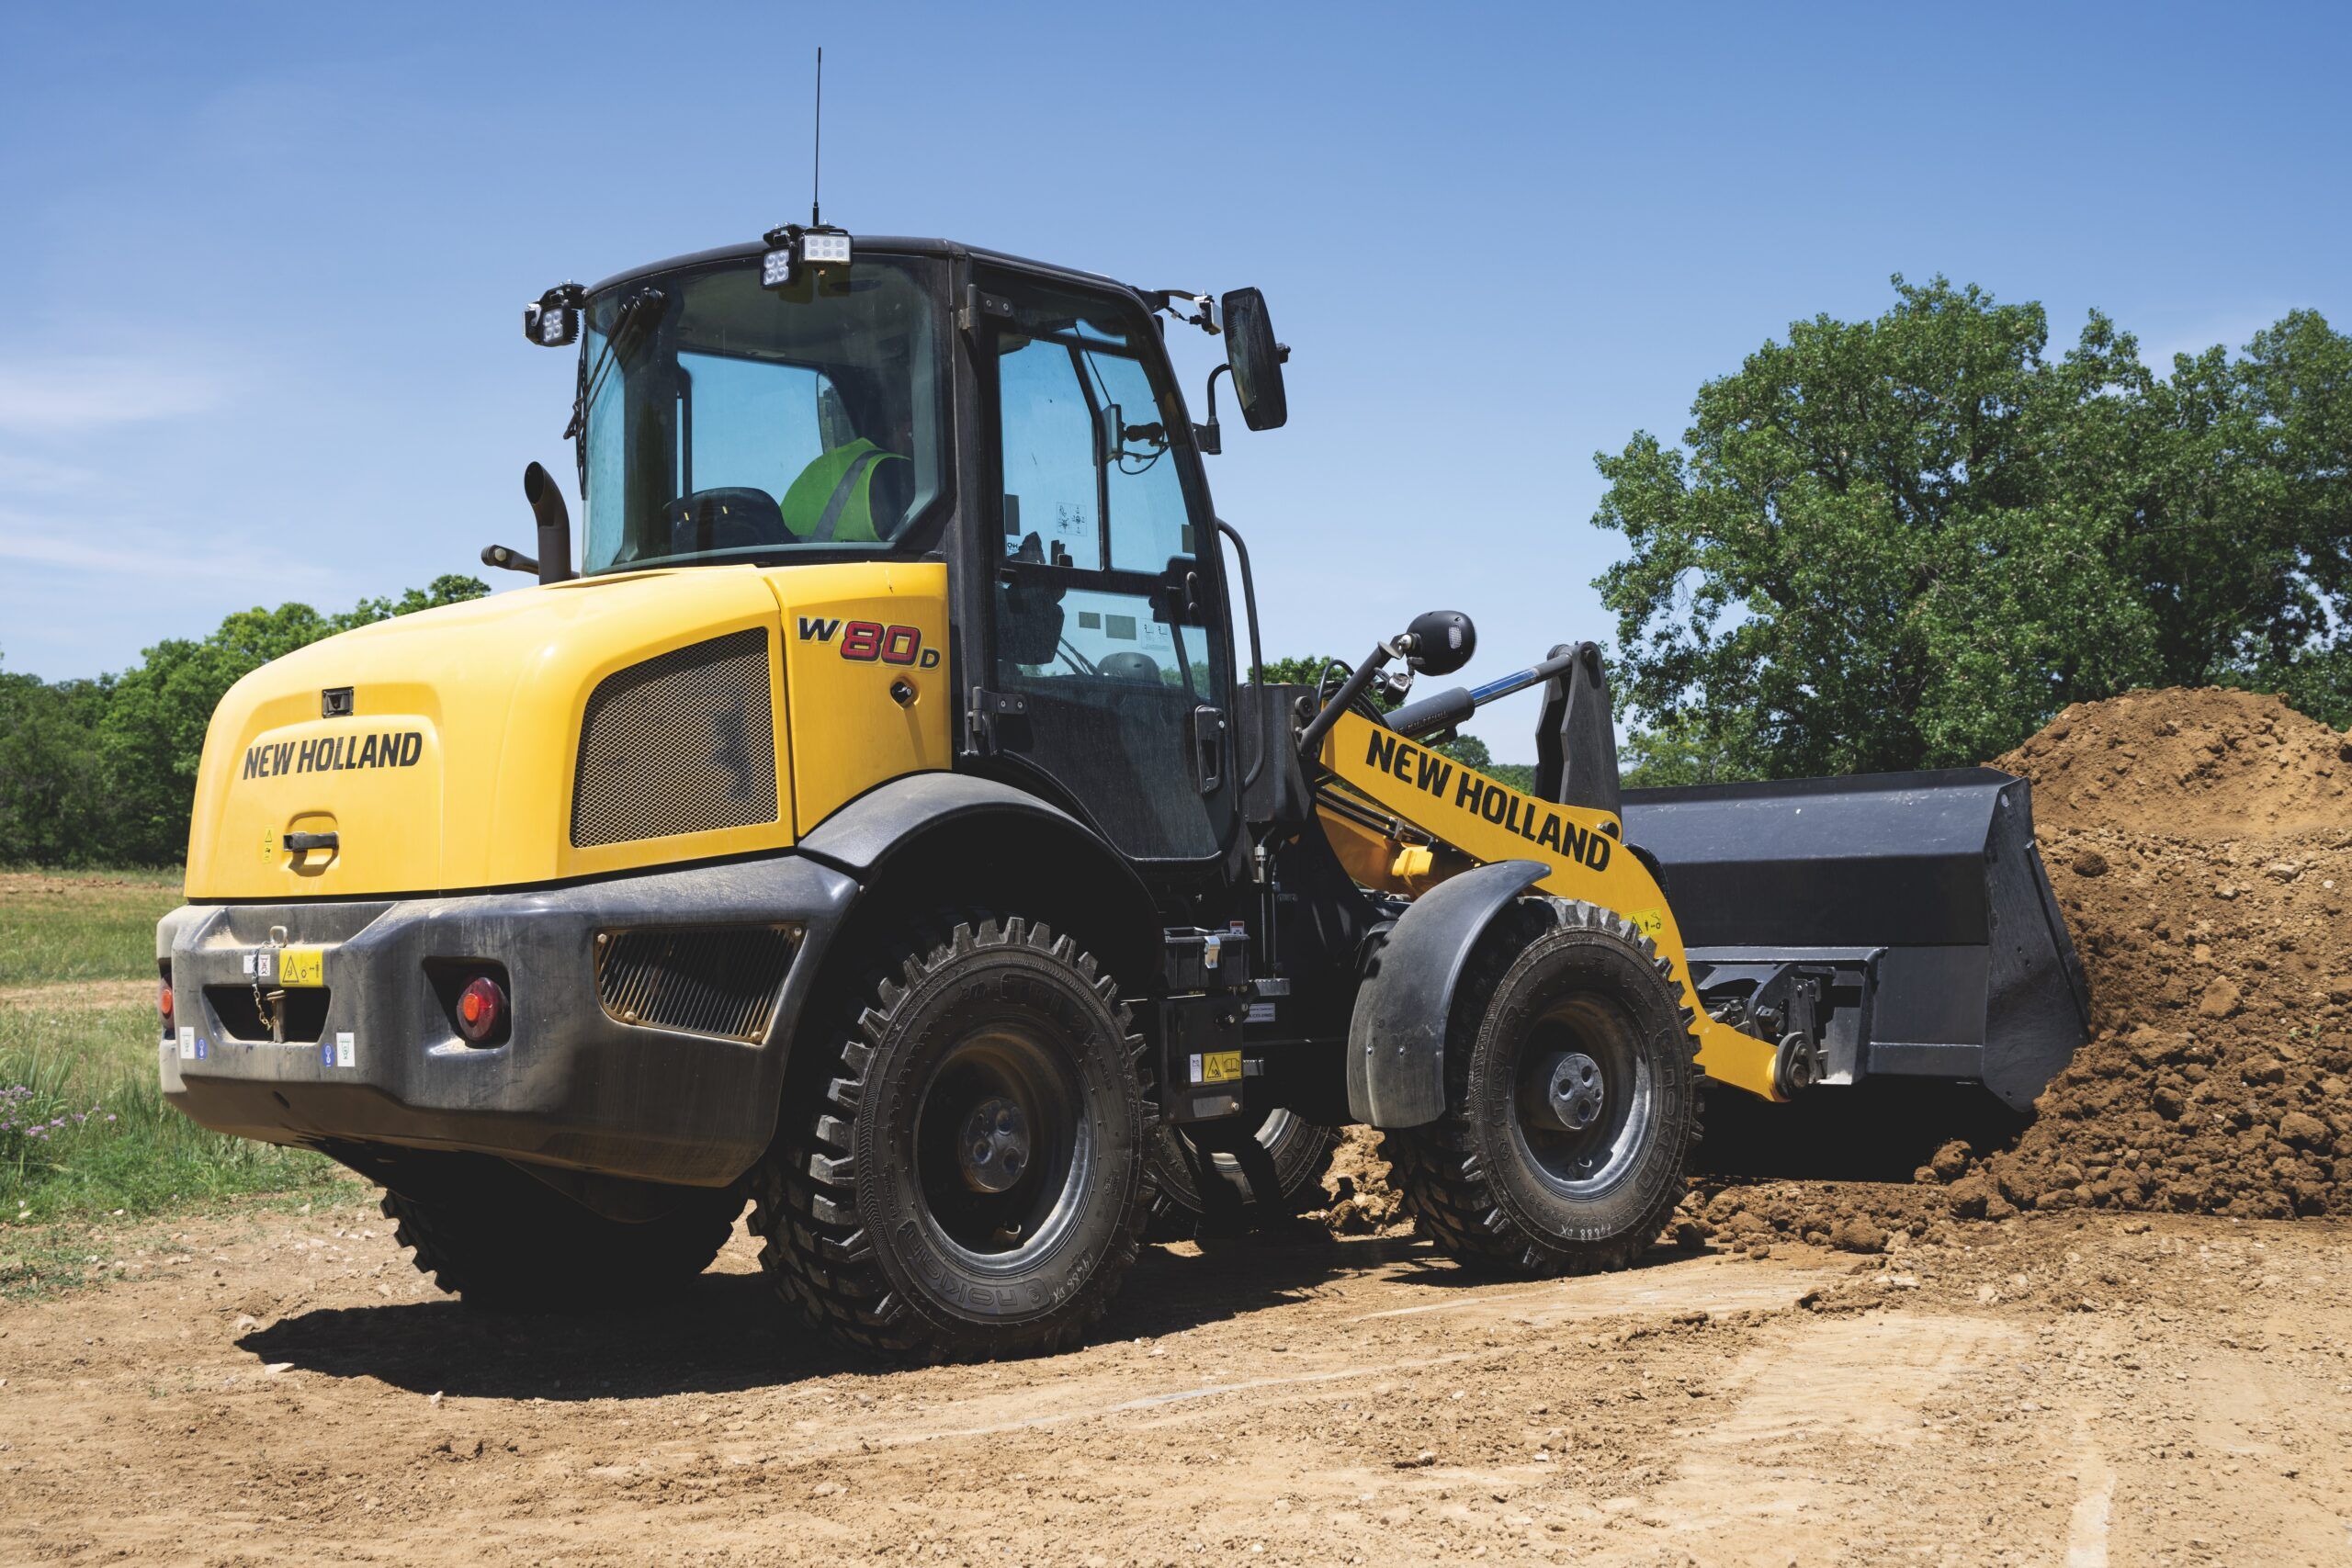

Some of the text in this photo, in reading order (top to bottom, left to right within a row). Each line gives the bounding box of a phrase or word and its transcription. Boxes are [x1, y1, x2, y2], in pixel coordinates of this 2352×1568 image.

[243, 731, 423, 780] NEW HOLLAND
[1365, 728, 1611, 873] NEW HOLLAND
